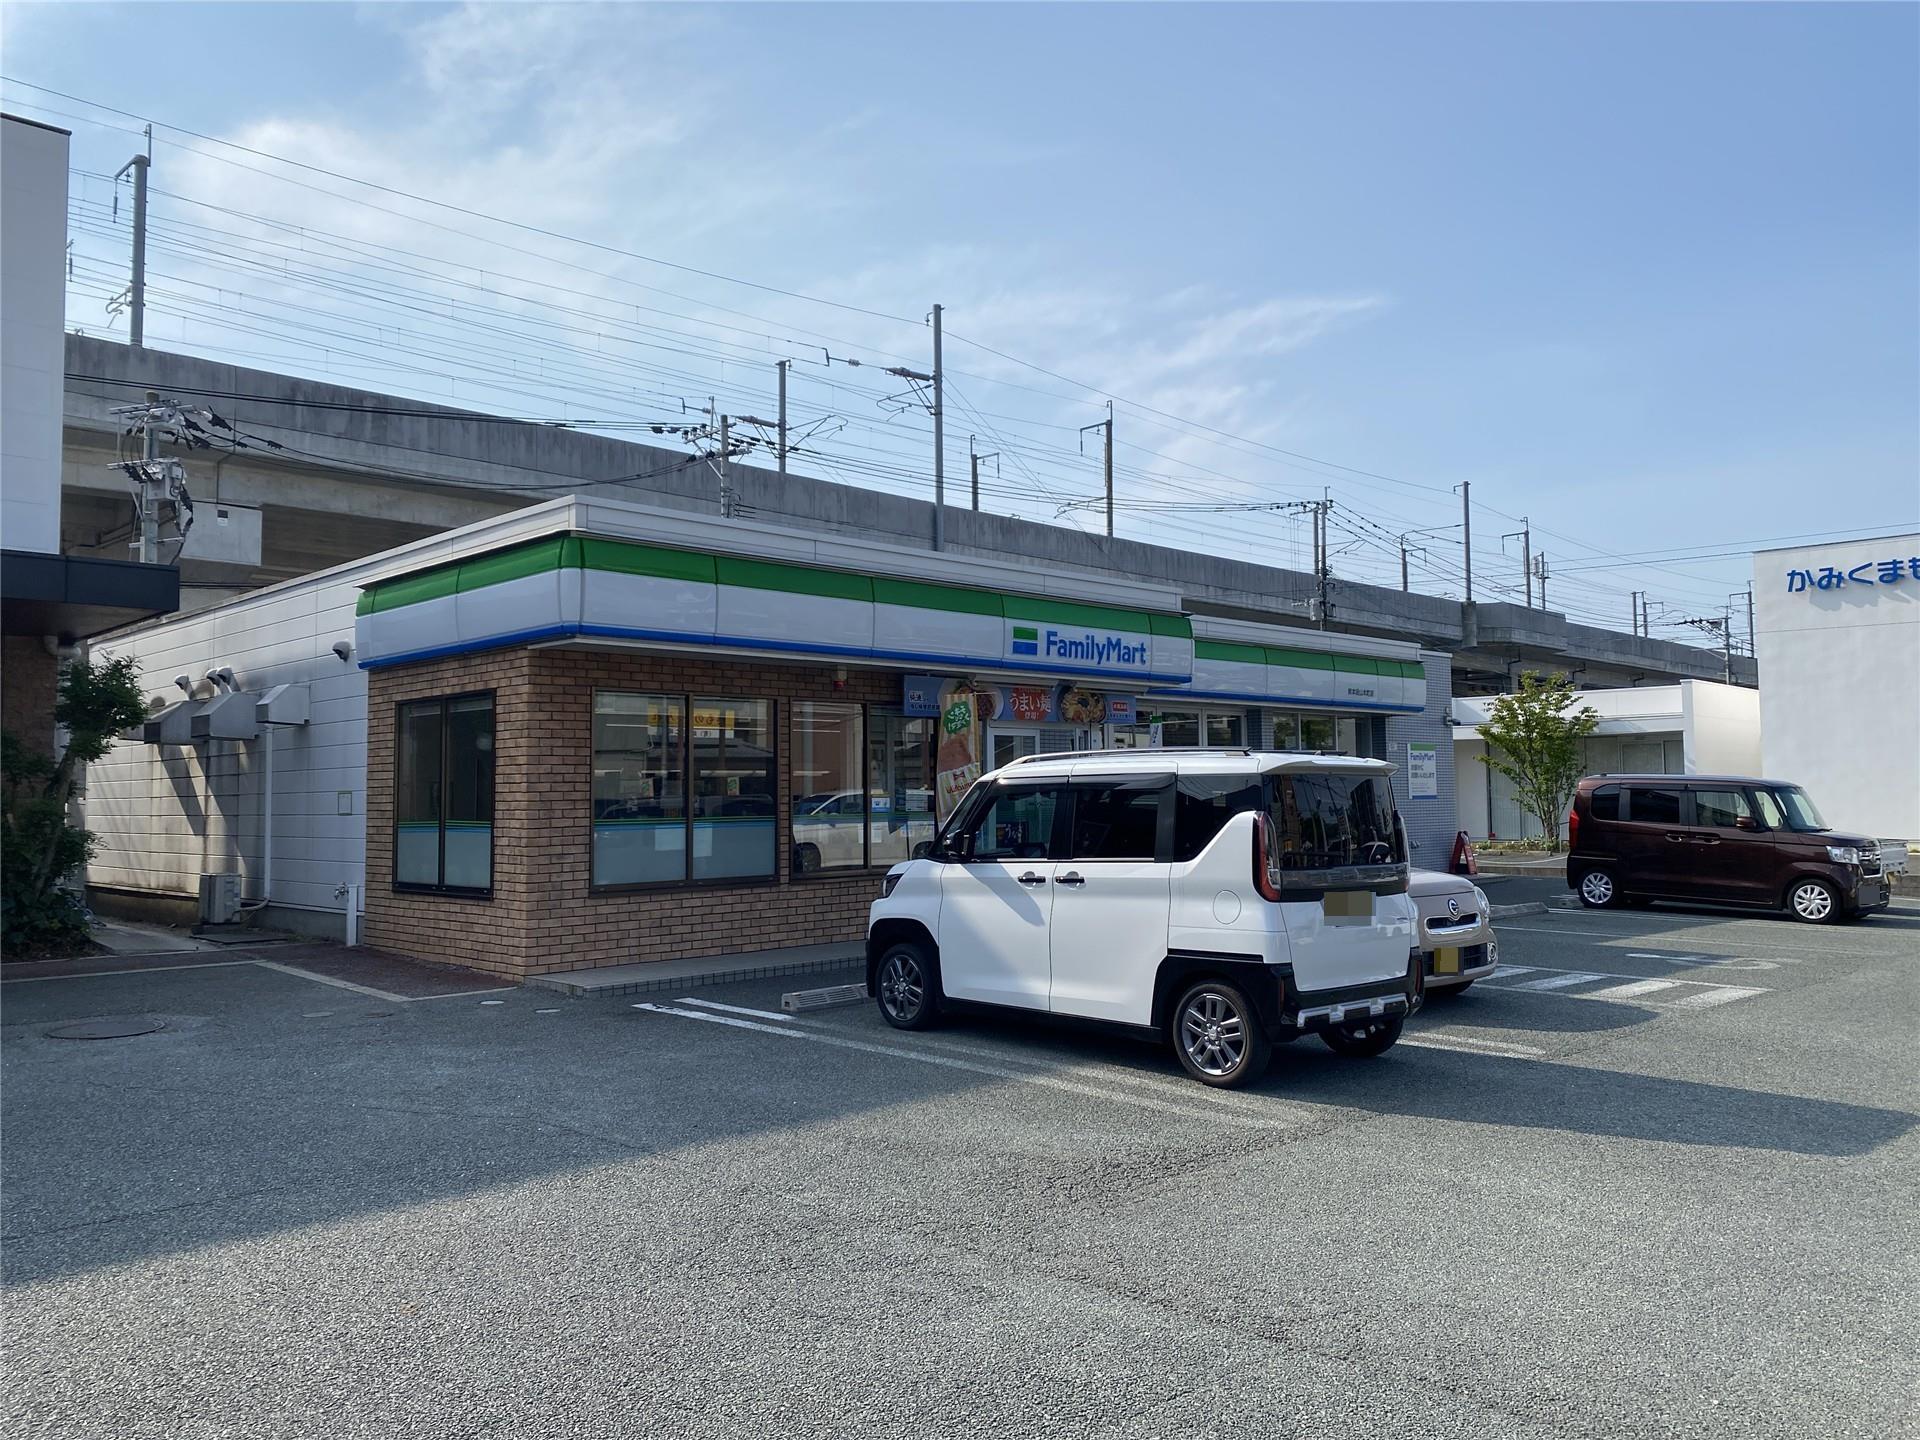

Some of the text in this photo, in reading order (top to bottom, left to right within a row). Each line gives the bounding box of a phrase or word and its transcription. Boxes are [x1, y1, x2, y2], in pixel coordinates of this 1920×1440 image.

[1046, 631, 1147, 665] FamilyMart
[1009, 694, 1051, 712] うまい麺
[1410, 753, 1435, 762] FamilyMart
